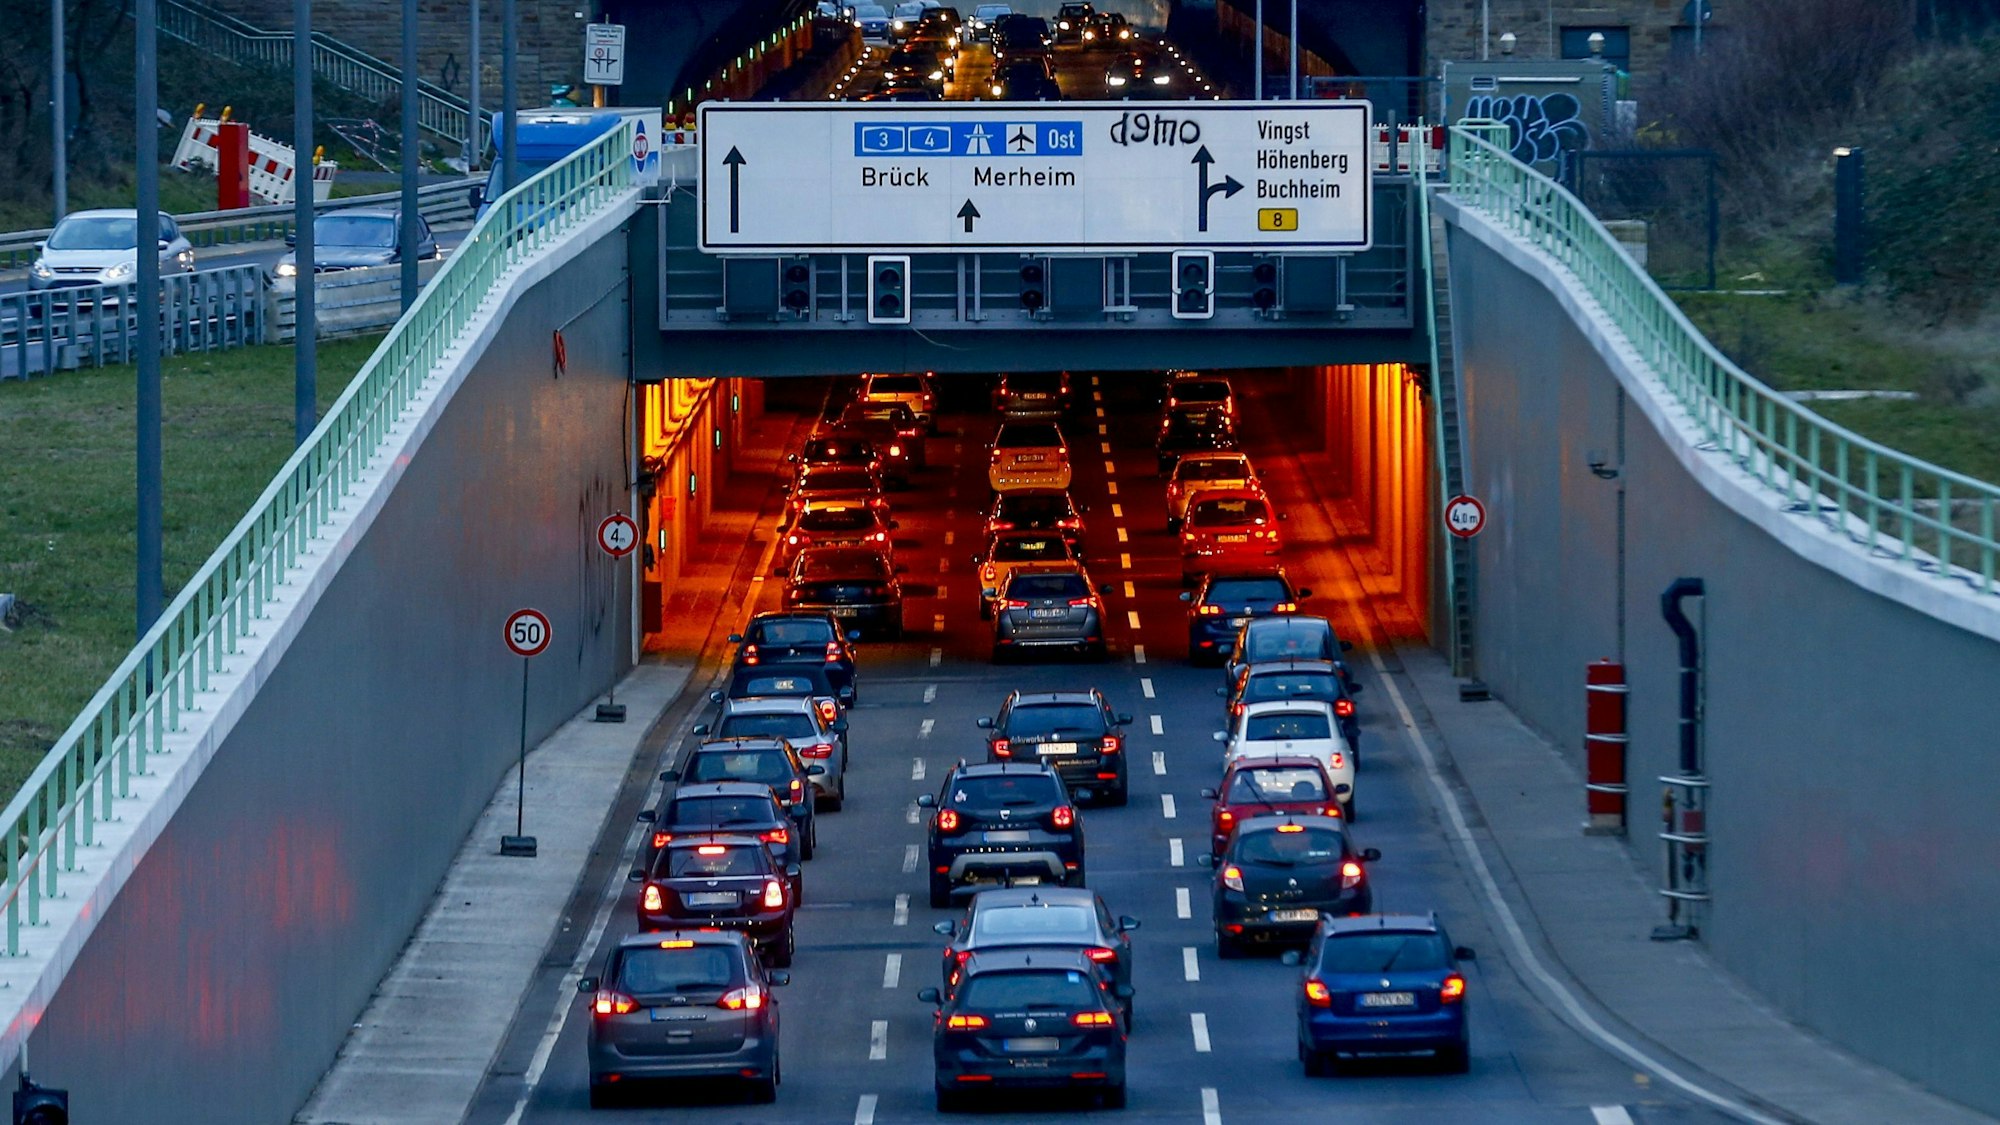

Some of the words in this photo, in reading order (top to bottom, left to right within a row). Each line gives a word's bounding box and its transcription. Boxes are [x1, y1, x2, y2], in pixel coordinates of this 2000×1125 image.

[878, 131, 889, 148] 3
[924, 131, 935, 148] 4
[1048, 128, 1076, 149] Ost
[1257, 119, 1310, 144] Vingst
[1257, 149, 1348, 173] Höhenberg
[862, 166, 929, 187] Brück
[974, 166, 1076, 187] Merheim
[1257, 178, 1341, 199] Buchheim
[1273, 212, 1283, 228] 8
[514, 622, 540, 644] 50
